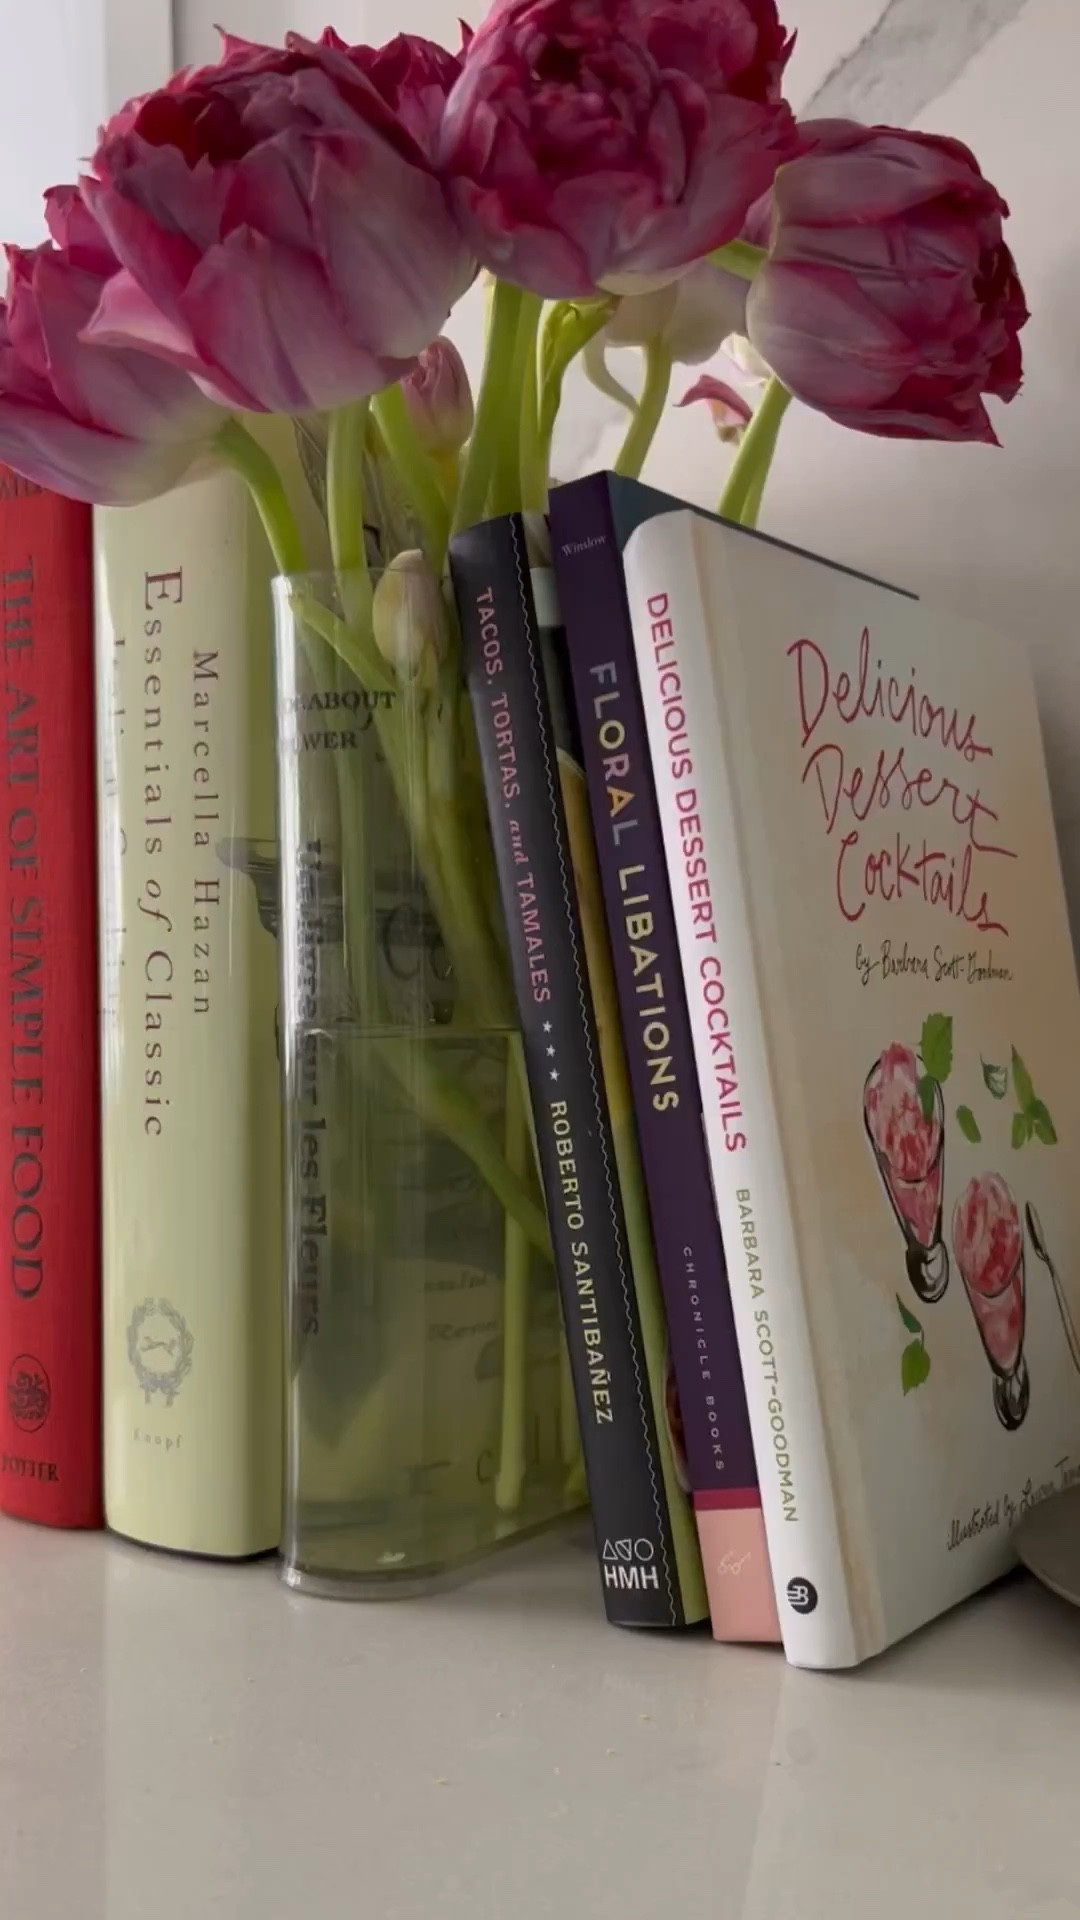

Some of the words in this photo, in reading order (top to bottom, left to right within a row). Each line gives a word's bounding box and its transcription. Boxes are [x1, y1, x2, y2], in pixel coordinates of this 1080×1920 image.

[2, 555, 34, 664] THE
[560, 533, 608, 558] Winslow
[5, 679, 40, 793] ART
[144, 566, 183, 856] Essentials
[193, 651, 220, 848] Marcella
[786, 626, 993, 762] Delicious
[8, 805, 38, 881] OF
[508, 820, 529, 865] and
[802, 743, 1018, 858] Dessert
[137, 878, 174, 932] of
[193, 878, 220, 1014] Hazan
[517, 872, 551, 1003] TAMALES
[589, 660, 639, 847] FLORAL
[617, 864, 680, 1111] LIBATIONS
[836, 830, 1009, 937] Cocktails
[9, 896, 45, 1105] SIMPLE
[144, 949, 174, 1137] Classic
[646, 592, 693, 779] DELICIOUS
[675, 788, 717, 943] DESSERT
[699, 956, 747, 1152] COCKTAILS
[735, 1188, 765, 1300] BARBARA
[754, 1310, 799, 1522] SCOTT-GOODMAN
[9, 1123, 45, 1299] FOOD
[300, 1118, 327, 1180] les
[550, 1101, 585, 1230] ROBERTO
[300, 1194, 328, 1336] Fleurs
[571, 1241, 614, 1425] SANTIBAÑEZ
[683, 1246, 711, 1381] CHRONICLE
[705, 1395, 725, 1471] BOOKS
[603, 1565, 660, 1590] HMH
